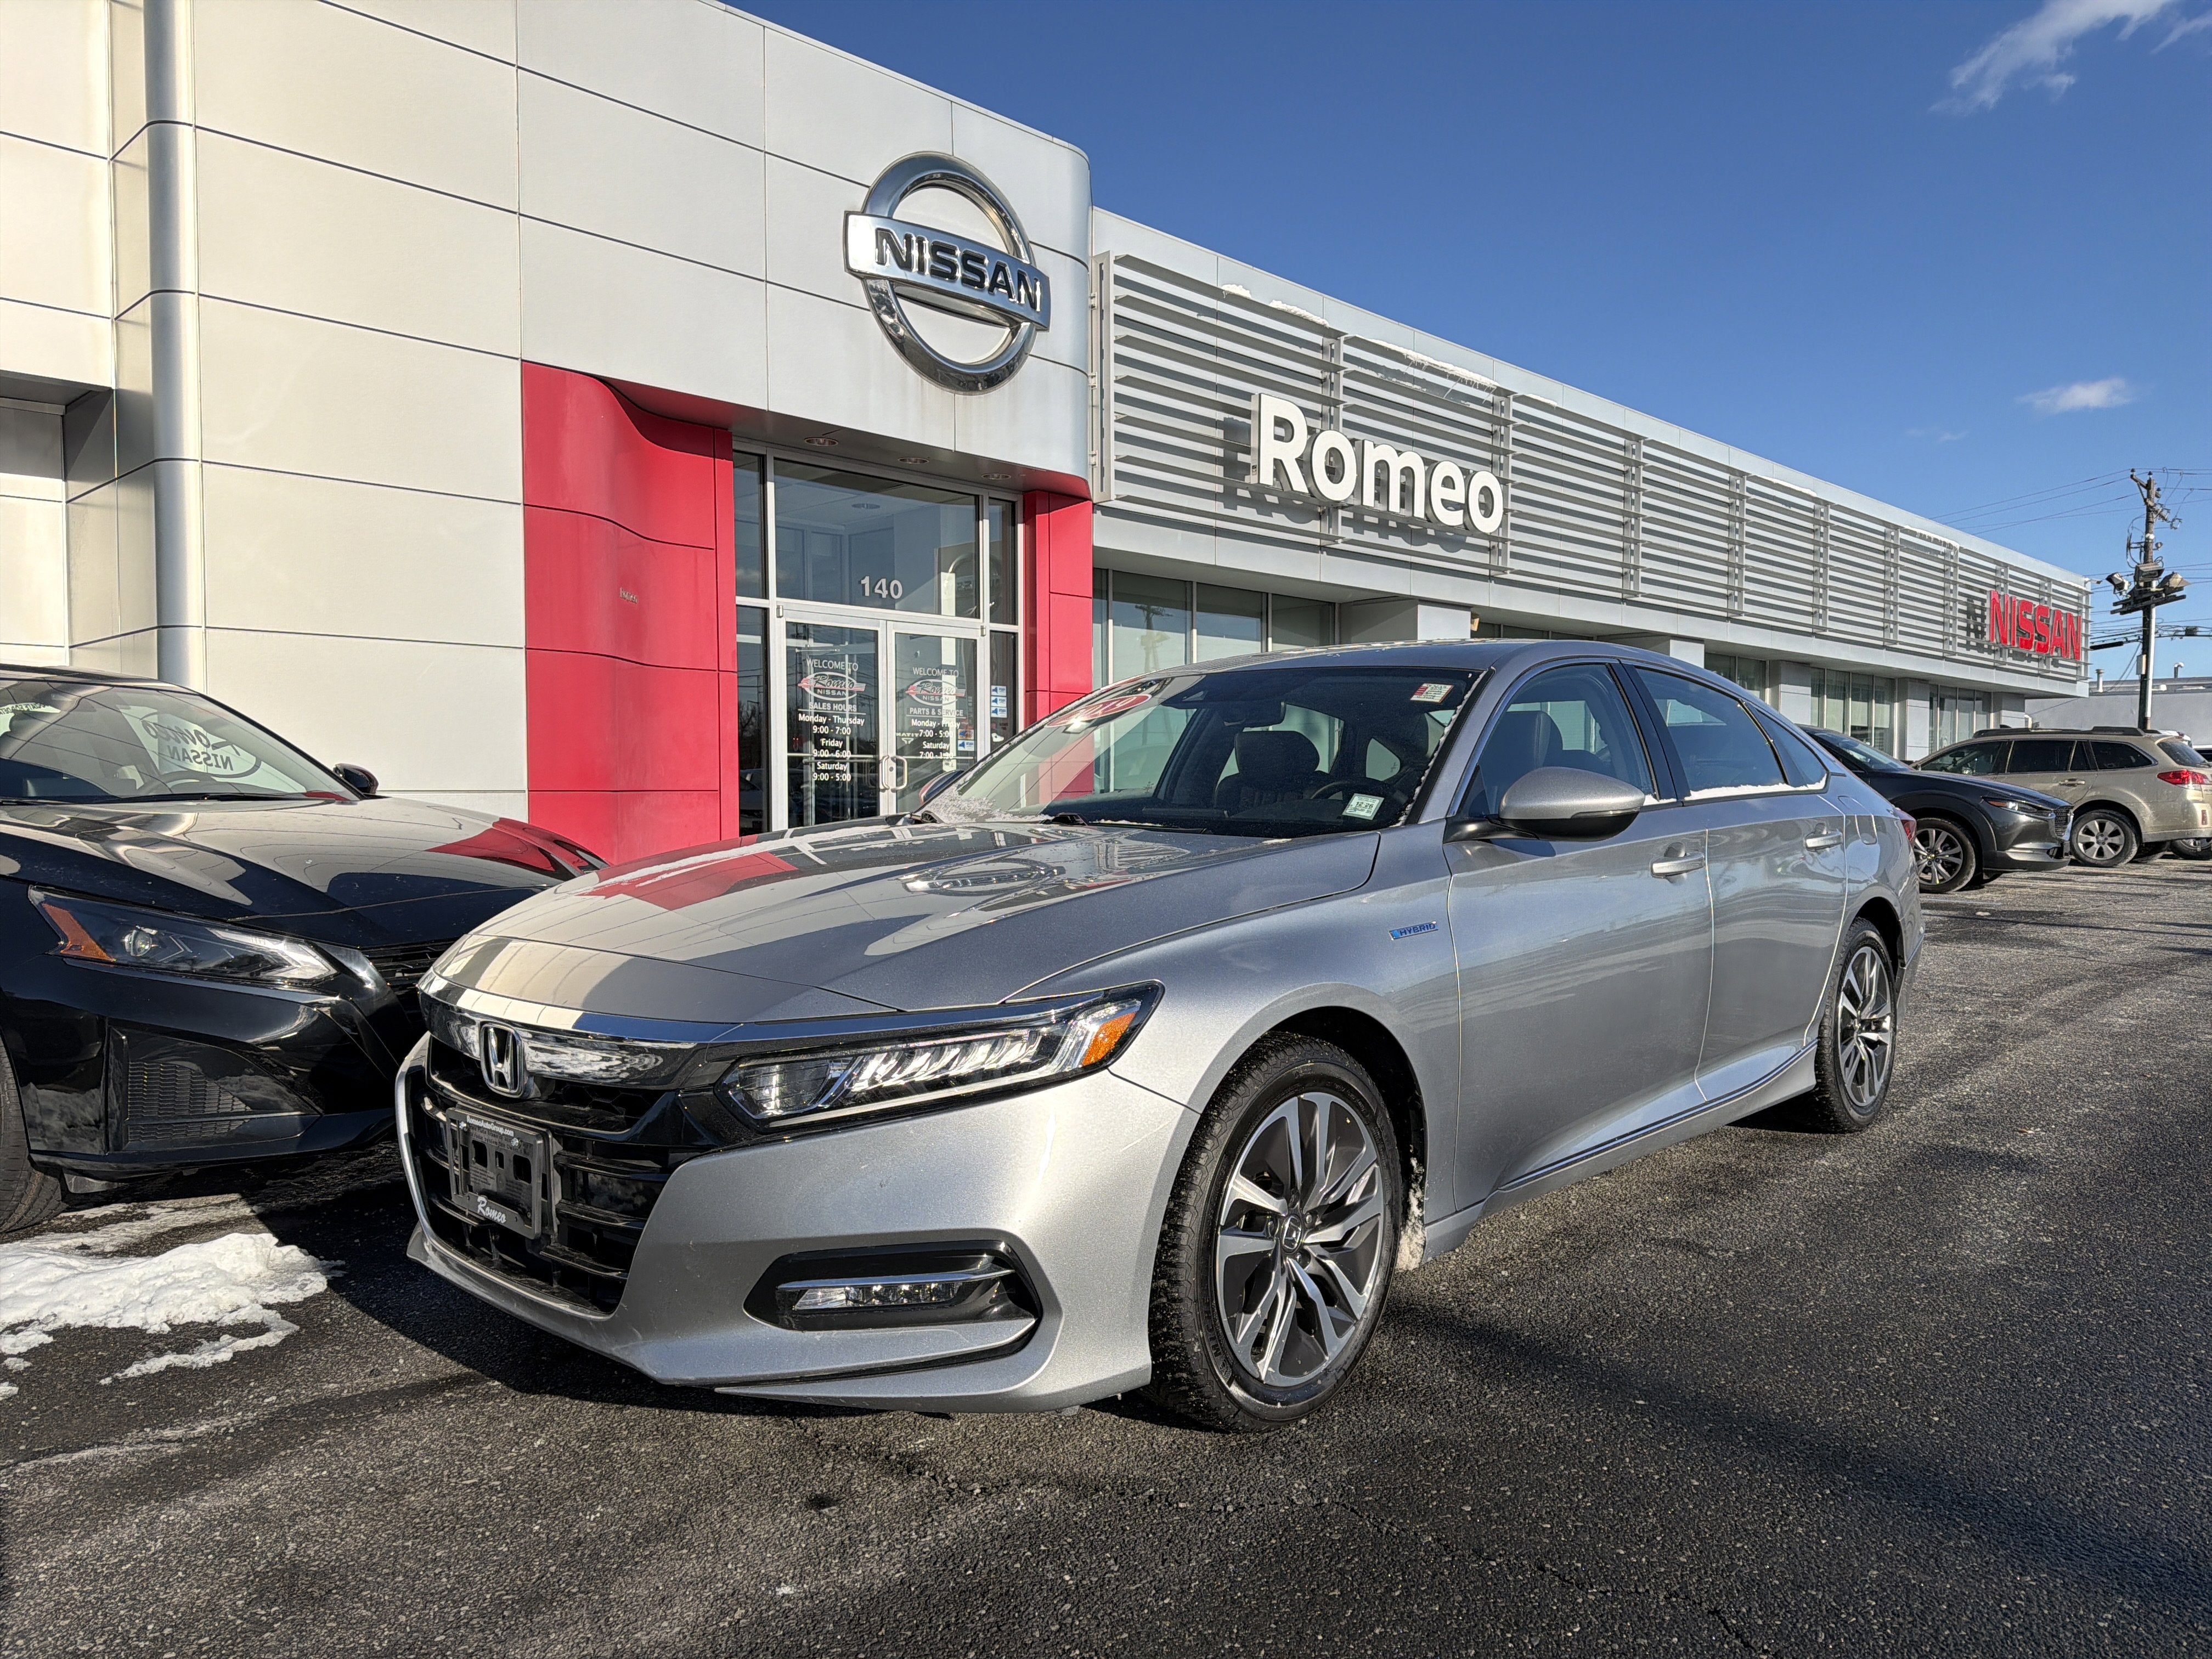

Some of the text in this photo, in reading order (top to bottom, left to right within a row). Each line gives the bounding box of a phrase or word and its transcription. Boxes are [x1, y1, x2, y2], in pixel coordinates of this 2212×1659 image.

[874, 227, 1041, 312] NISSAN
[1252, 393, 1504, 534] Romeo
[861, 576, 902, 599] 140
[1988, 590, 2083, 661] NISSAN
[806, 658, 859, 671] WELCOME TO
[912, 667, 959, 678] WELCOME TO
[814, 673, 855, 689] Romo
[809, 702, 857, 712] SALES HOURS
[937, 708, 964, 716] SERVICE
[798, 713, 827, 724] Monday
[833, 715, 865, 726] Thursday
[911, 719, 936, 729] Monday
[812, 725, 829, 733] 9:00
[836, 726, 851, 735] 7:00
[821, 738, 843, 748] Friday
[922, 741, 950, 751] Saturday
[836, 750, 851, 758] 6:00
[817, 761, 848, 771] Saturday
[812, 772, 829, 781] 9:00
[836, 773, 851, 781] 5:00
[1400, 923, 1436, 936] HYBRID
[477, 1196, 506, 1223] Romeo
